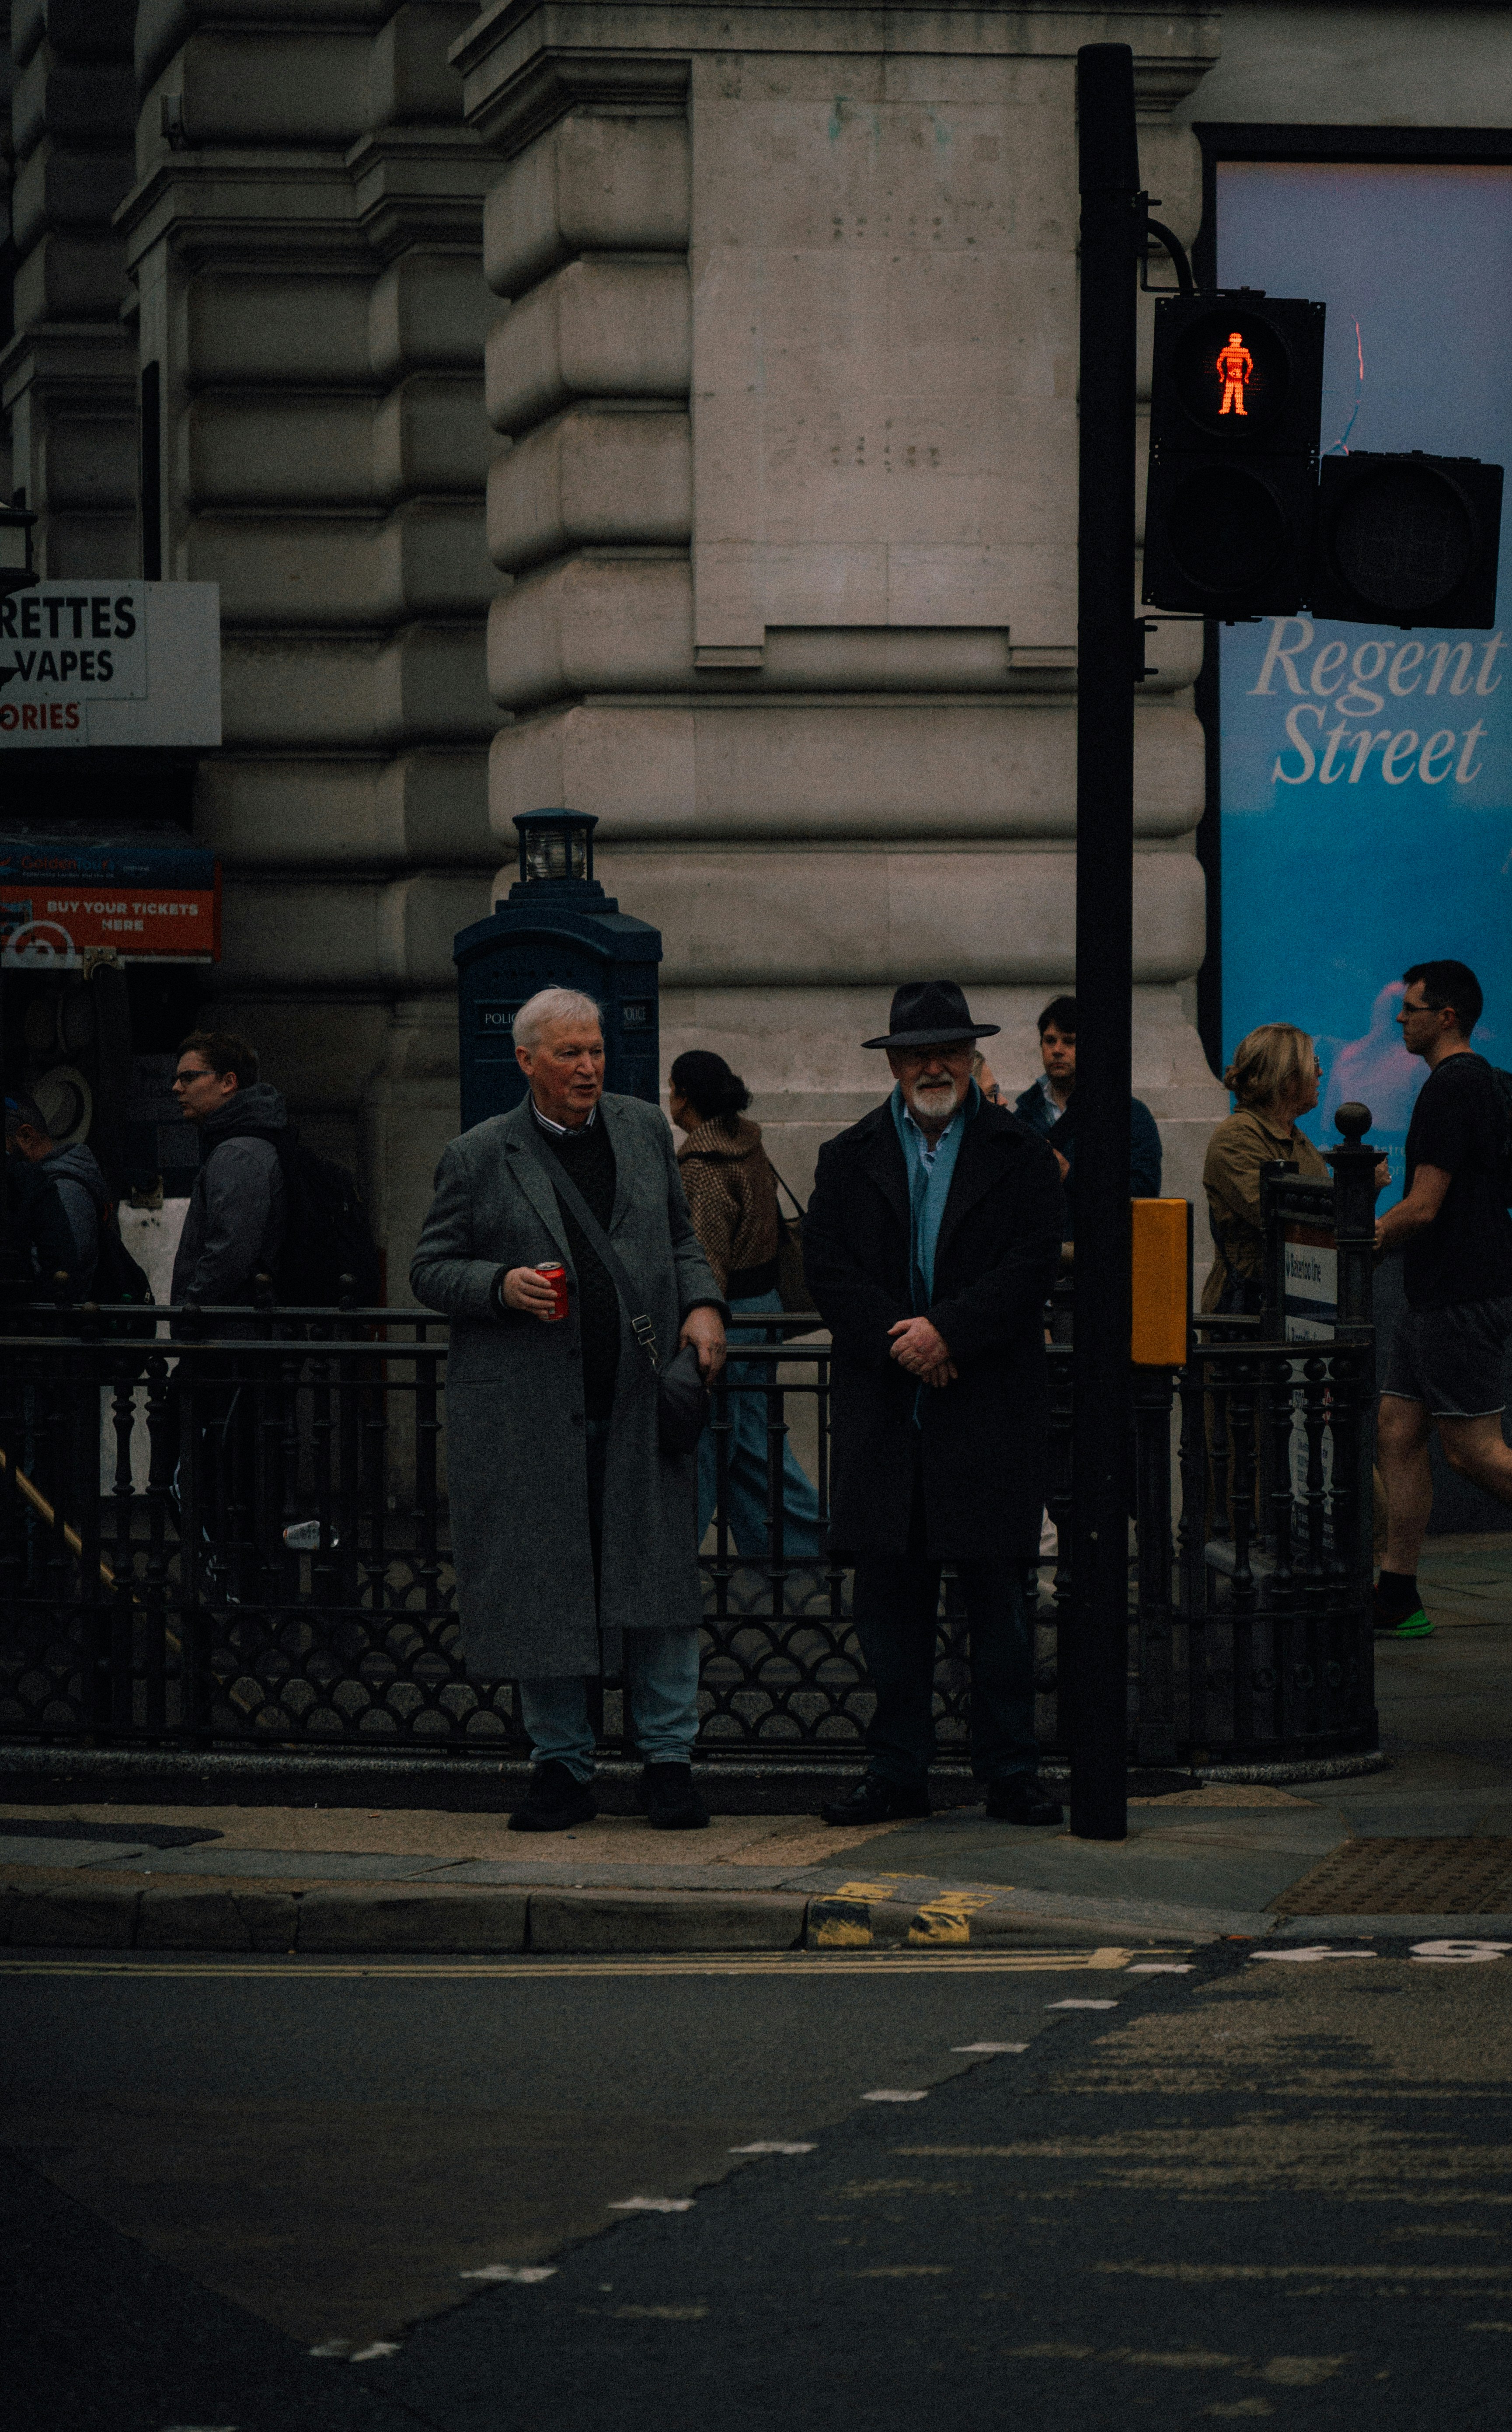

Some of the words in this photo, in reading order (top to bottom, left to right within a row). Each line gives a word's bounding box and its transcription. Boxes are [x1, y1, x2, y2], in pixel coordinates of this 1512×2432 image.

[0, 597, 136, 639] RETTES
[14, 650, 113, 681] VAPES
[1247, 616, 1508, 717] Regent
[0, 704, 80, 730] ORIES
[1272, 704, 1488, 785] Street
[47, 901, 80, 913] BUY
[84, 901, 127, 914] YOUR
[132, 902, 199, 916] TICKETS
[102, 919, 143, 931] HERE
